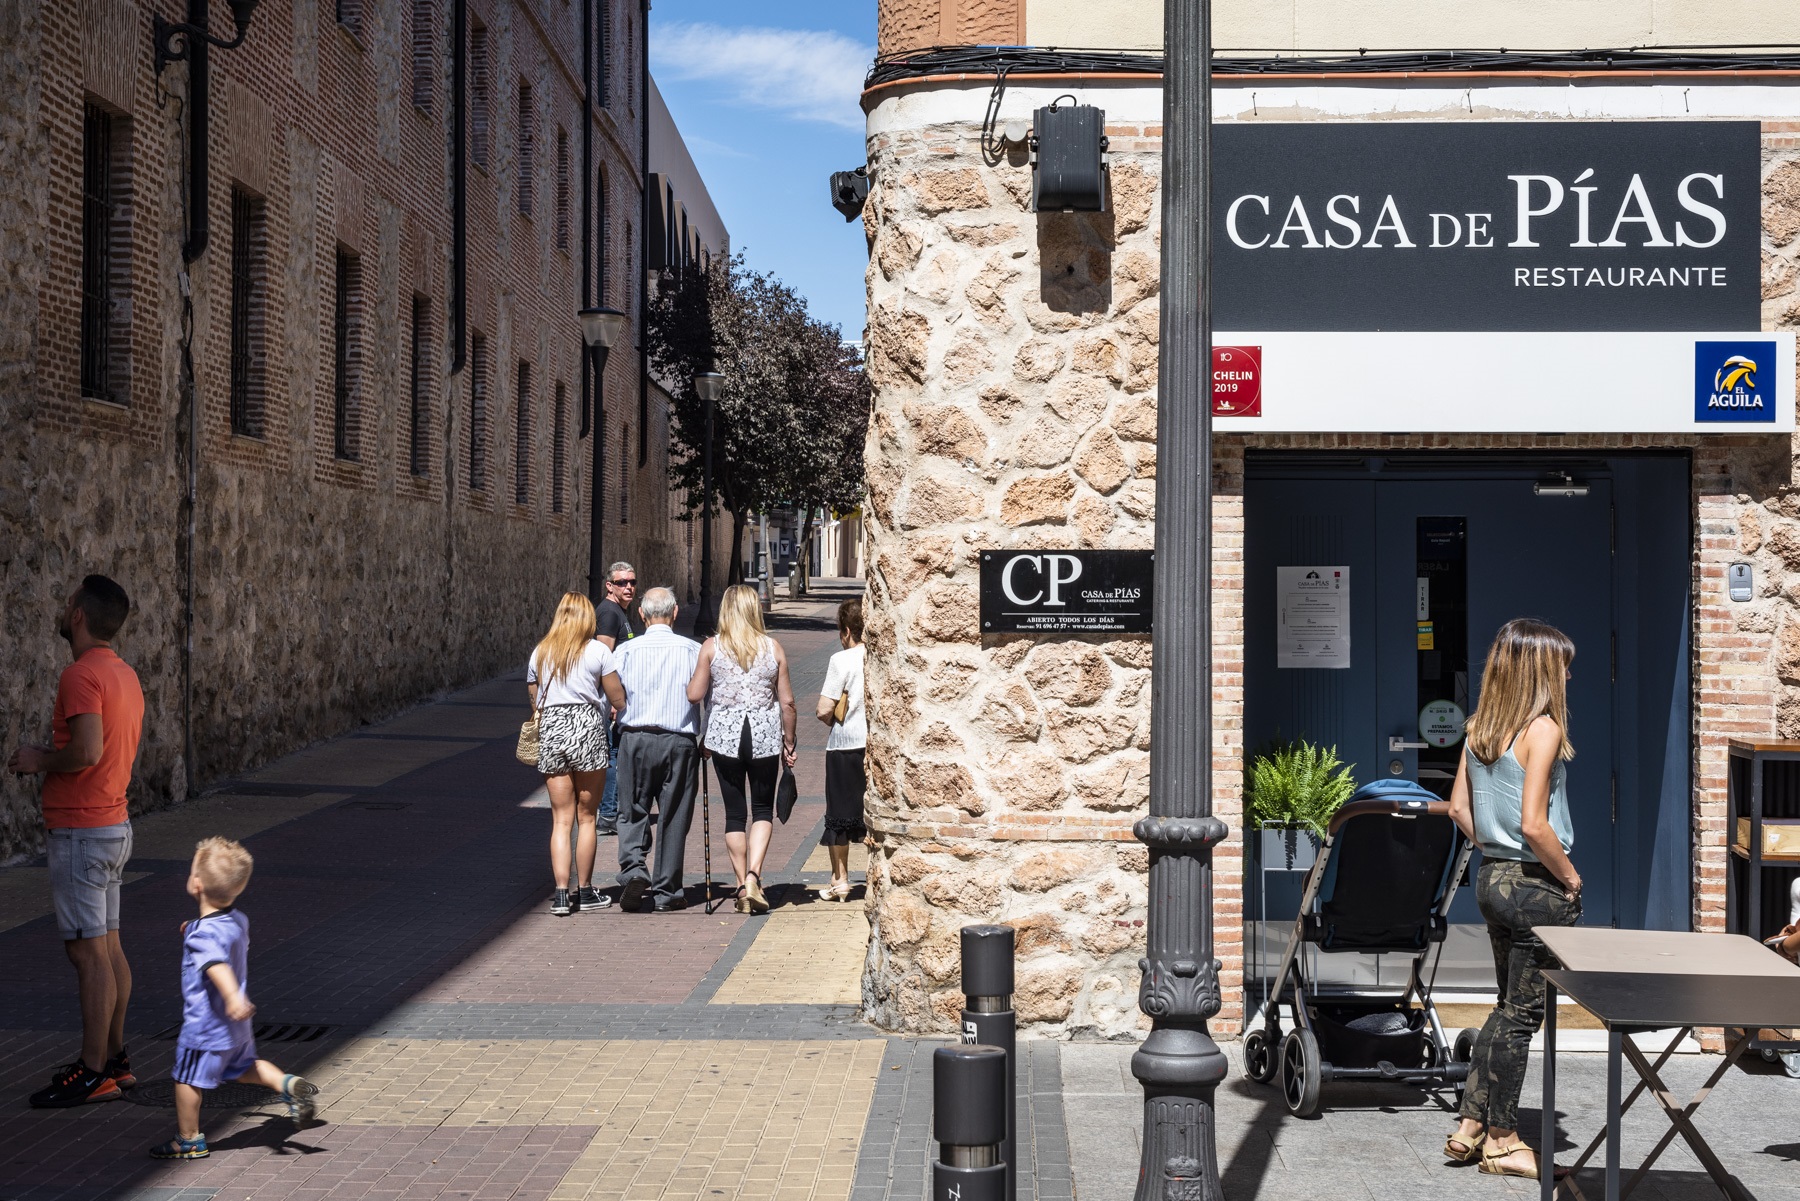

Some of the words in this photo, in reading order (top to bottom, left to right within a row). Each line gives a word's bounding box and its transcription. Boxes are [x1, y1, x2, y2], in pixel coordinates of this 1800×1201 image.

[1226, 195, 1416, 249] CASA
[1429, 213, 1494, 248] DE
[1508, 168, 1727, 248] PÍAS
[1515, 267, 1727, 287] RESTAURANTE
[1213, 371, 1253, 381] CHELIN
[1214, 383, 1238, 393] 2019
[1735, 386, 1745, 394] EL
[1708, 393, 1764, 407] ÁGUILA
[1001, 554, 1083, 606] CP
[1081, 590, 1104, 599] CASA
[1114, 587, 1141, 599] PÍAS
